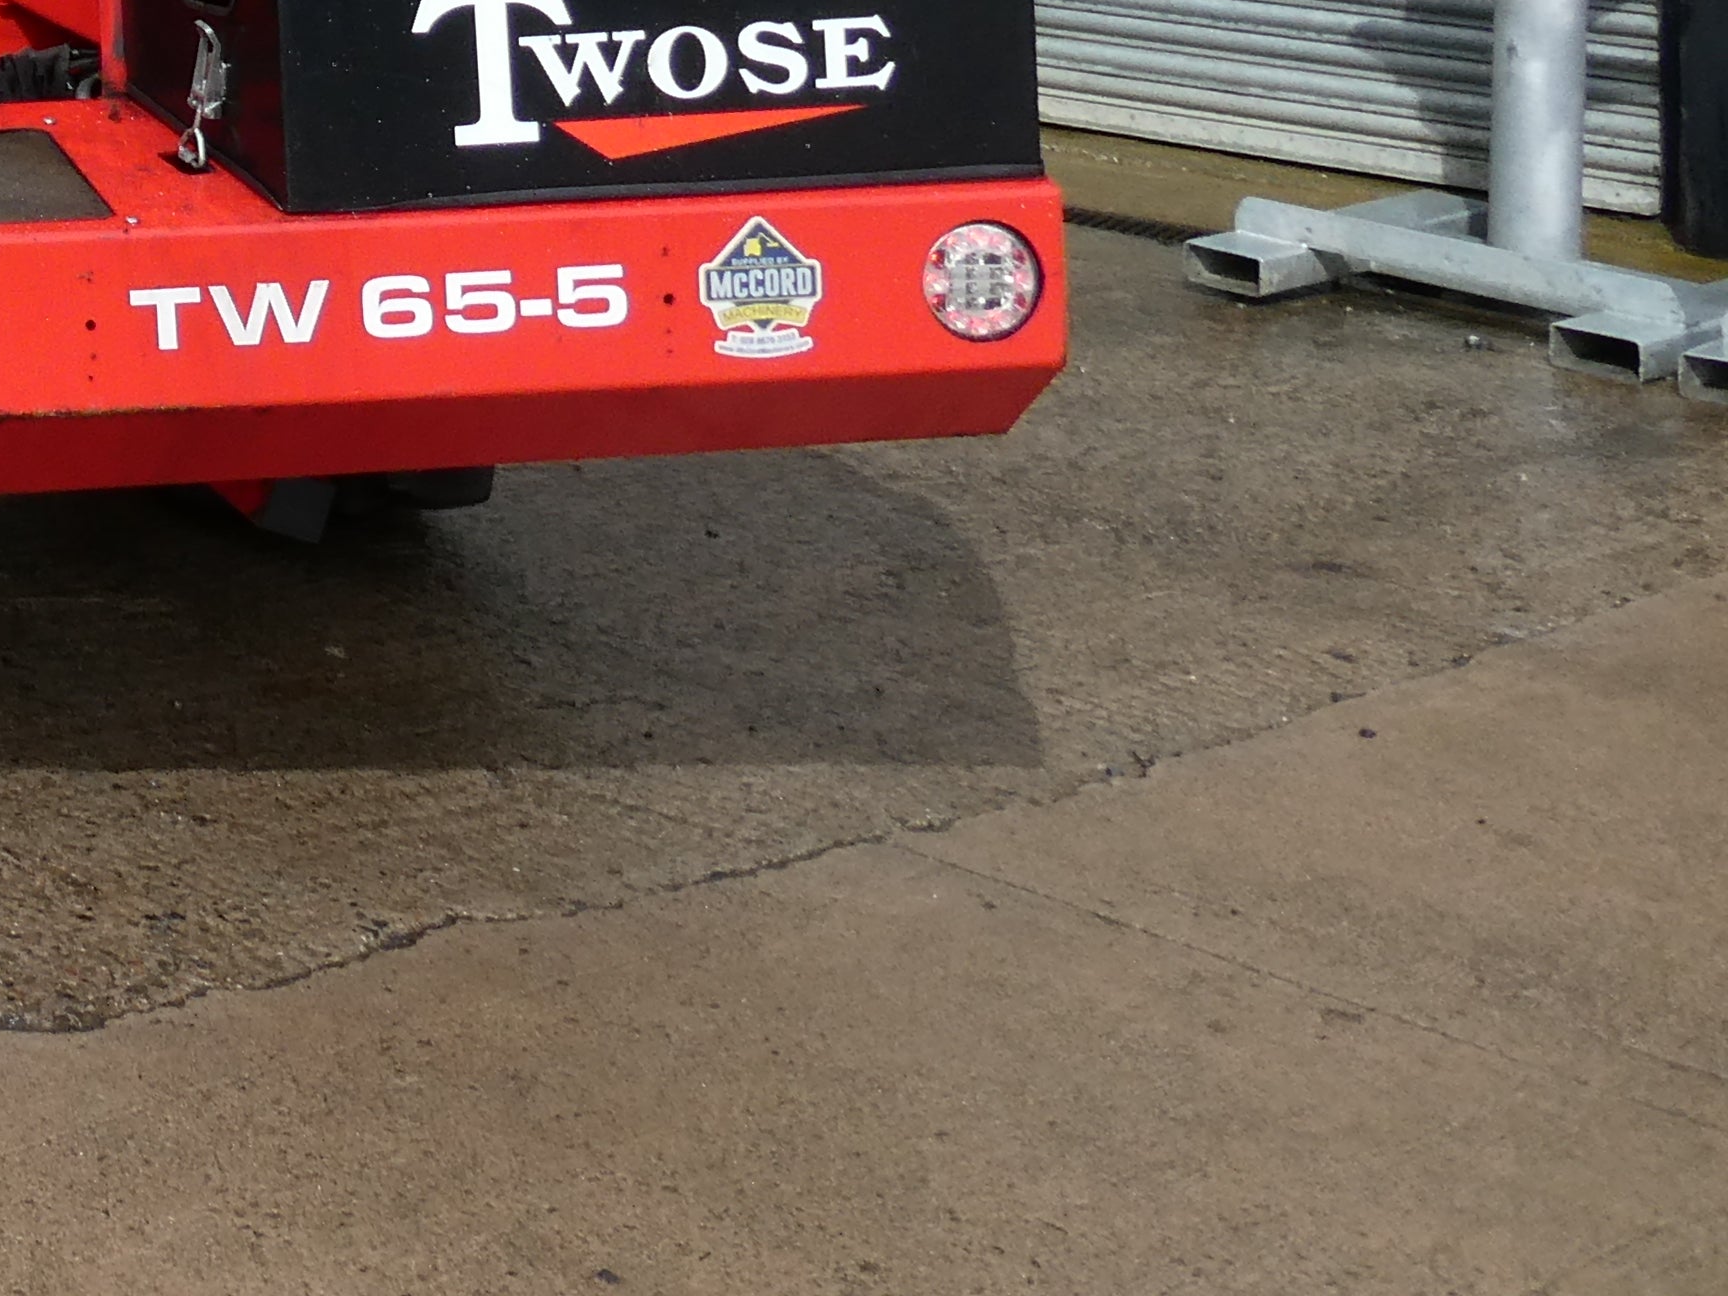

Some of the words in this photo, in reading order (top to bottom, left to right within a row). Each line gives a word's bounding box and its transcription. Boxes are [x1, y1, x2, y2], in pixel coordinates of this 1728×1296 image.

[129, 279, 330, 350] TW
[362, 264, 628, 338] 65-5
[722, 304, 804, 322] MACHINERY
